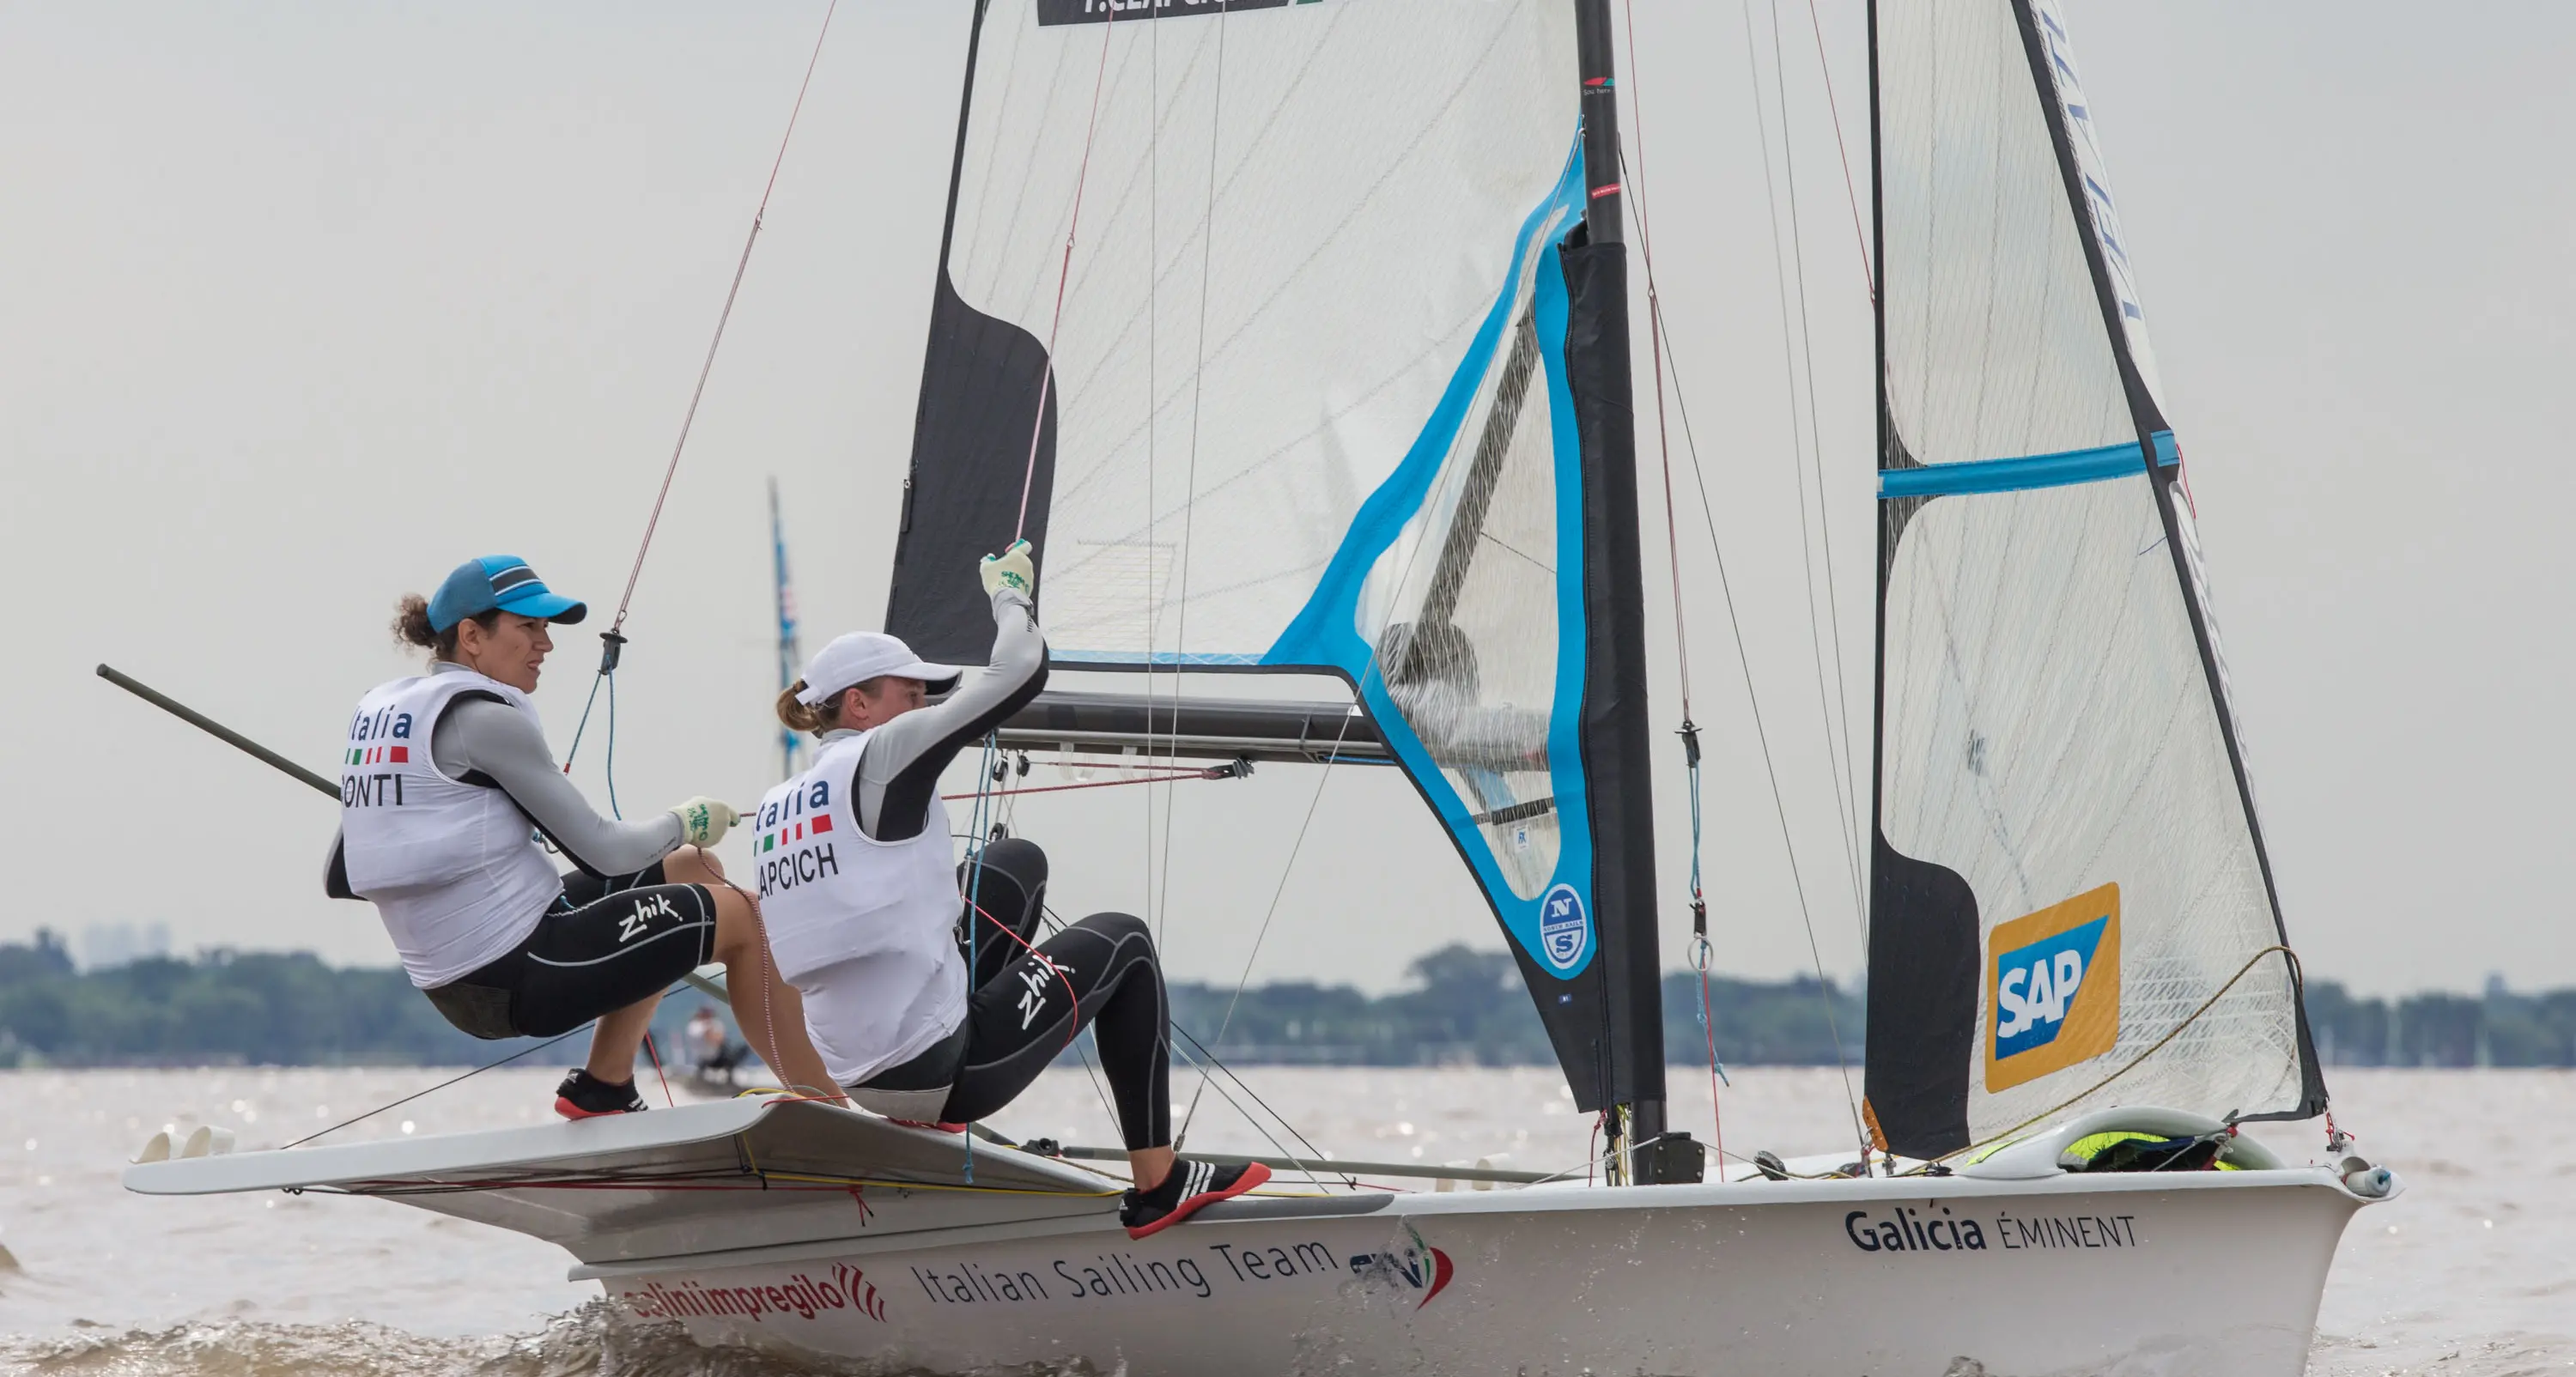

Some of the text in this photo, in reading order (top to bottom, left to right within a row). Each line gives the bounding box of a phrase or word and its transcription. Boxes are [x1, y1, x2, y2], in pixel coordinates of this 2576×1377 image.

[342, 774, 403, 808] ONTI
[756, 780, 829, 831] talia
[757, 843, 839, 901] APCICH
[1551, 898, 1572, 918] N
[1555, 934, 1573, 953] S
[1997, 949, 2081, 1038] SAP
[1845, 1202, 1987, 1252] Galicia
[911, 1264, 1048, 1303] Italian
[1054, 1253, 1212, 1298] Sailing
[1211, 1241, 1339, 1282] Team
